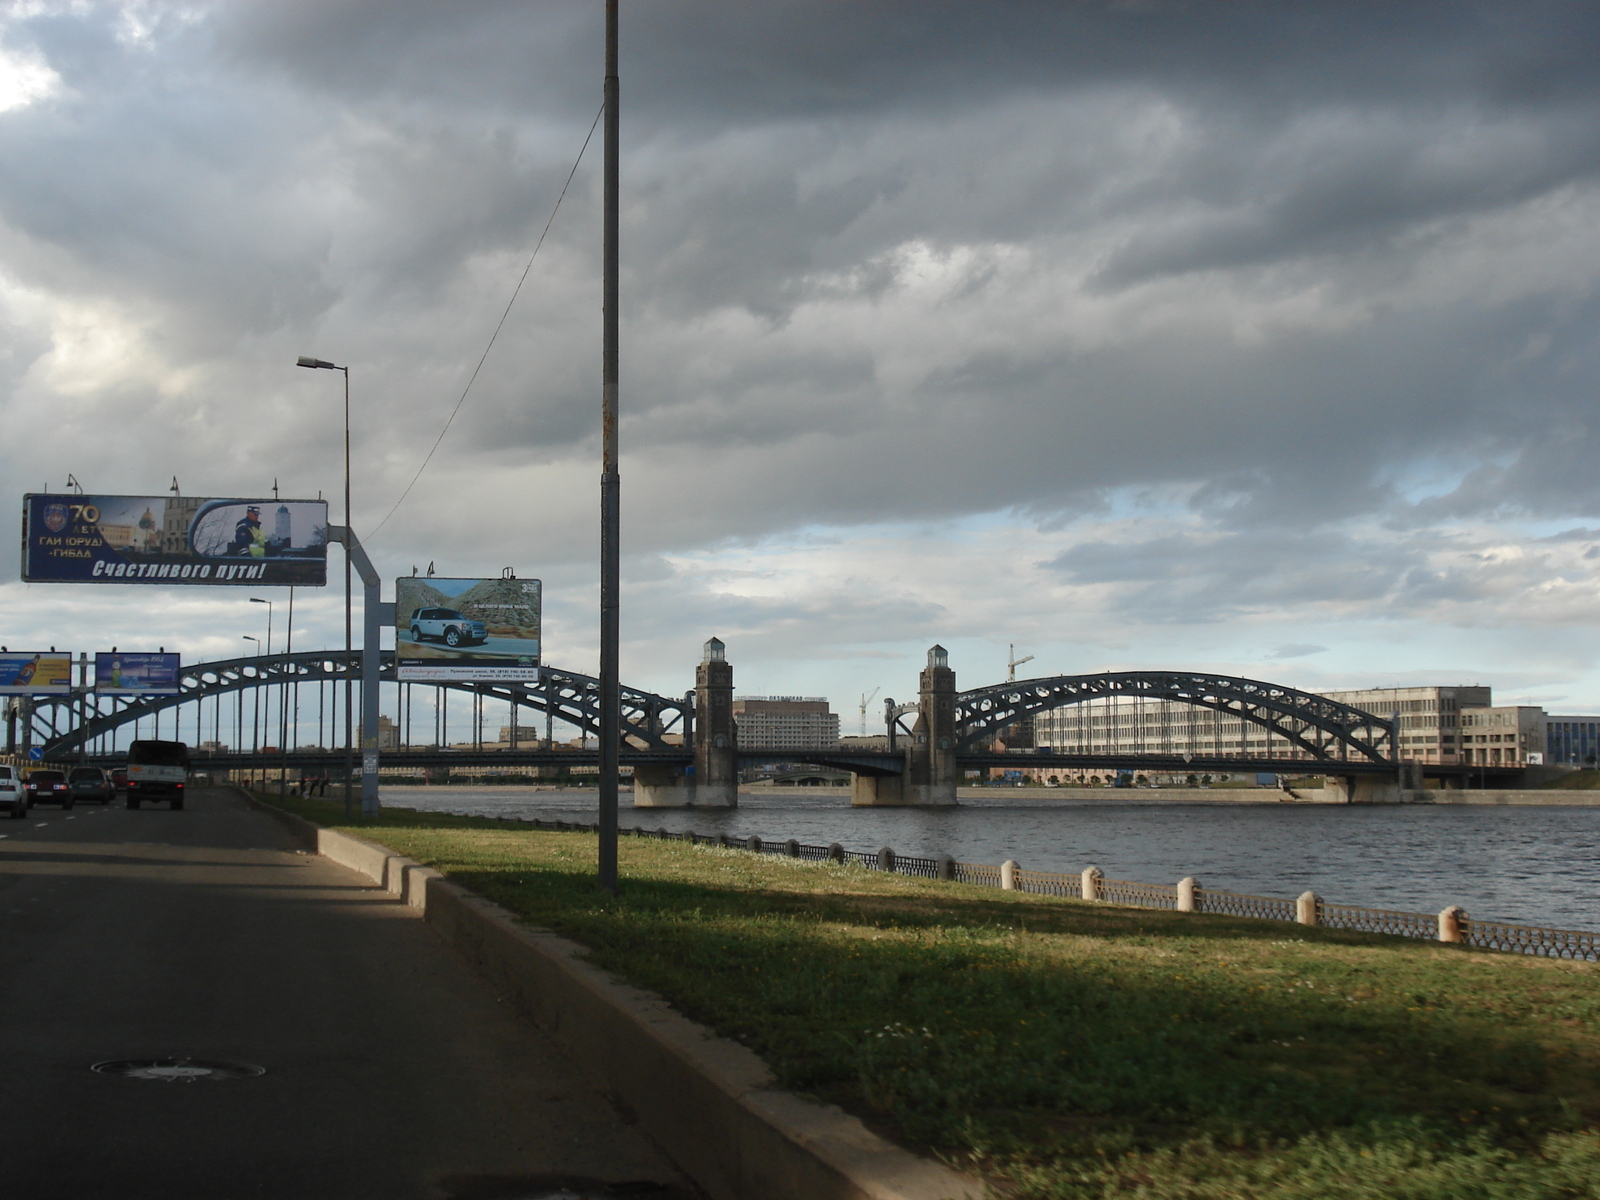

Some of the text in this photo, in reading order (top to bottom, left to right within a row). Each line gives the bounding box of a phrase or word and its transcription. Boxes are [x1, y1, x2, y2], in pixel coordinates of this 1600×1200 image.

[69, 505, 100, 523] 70
[73, 525, 97, 534] ЛЕТ
[39, 537, 103, 547] ГАИ (ОРУД)
[92, 560, 268, 580] Счастливого пути!
